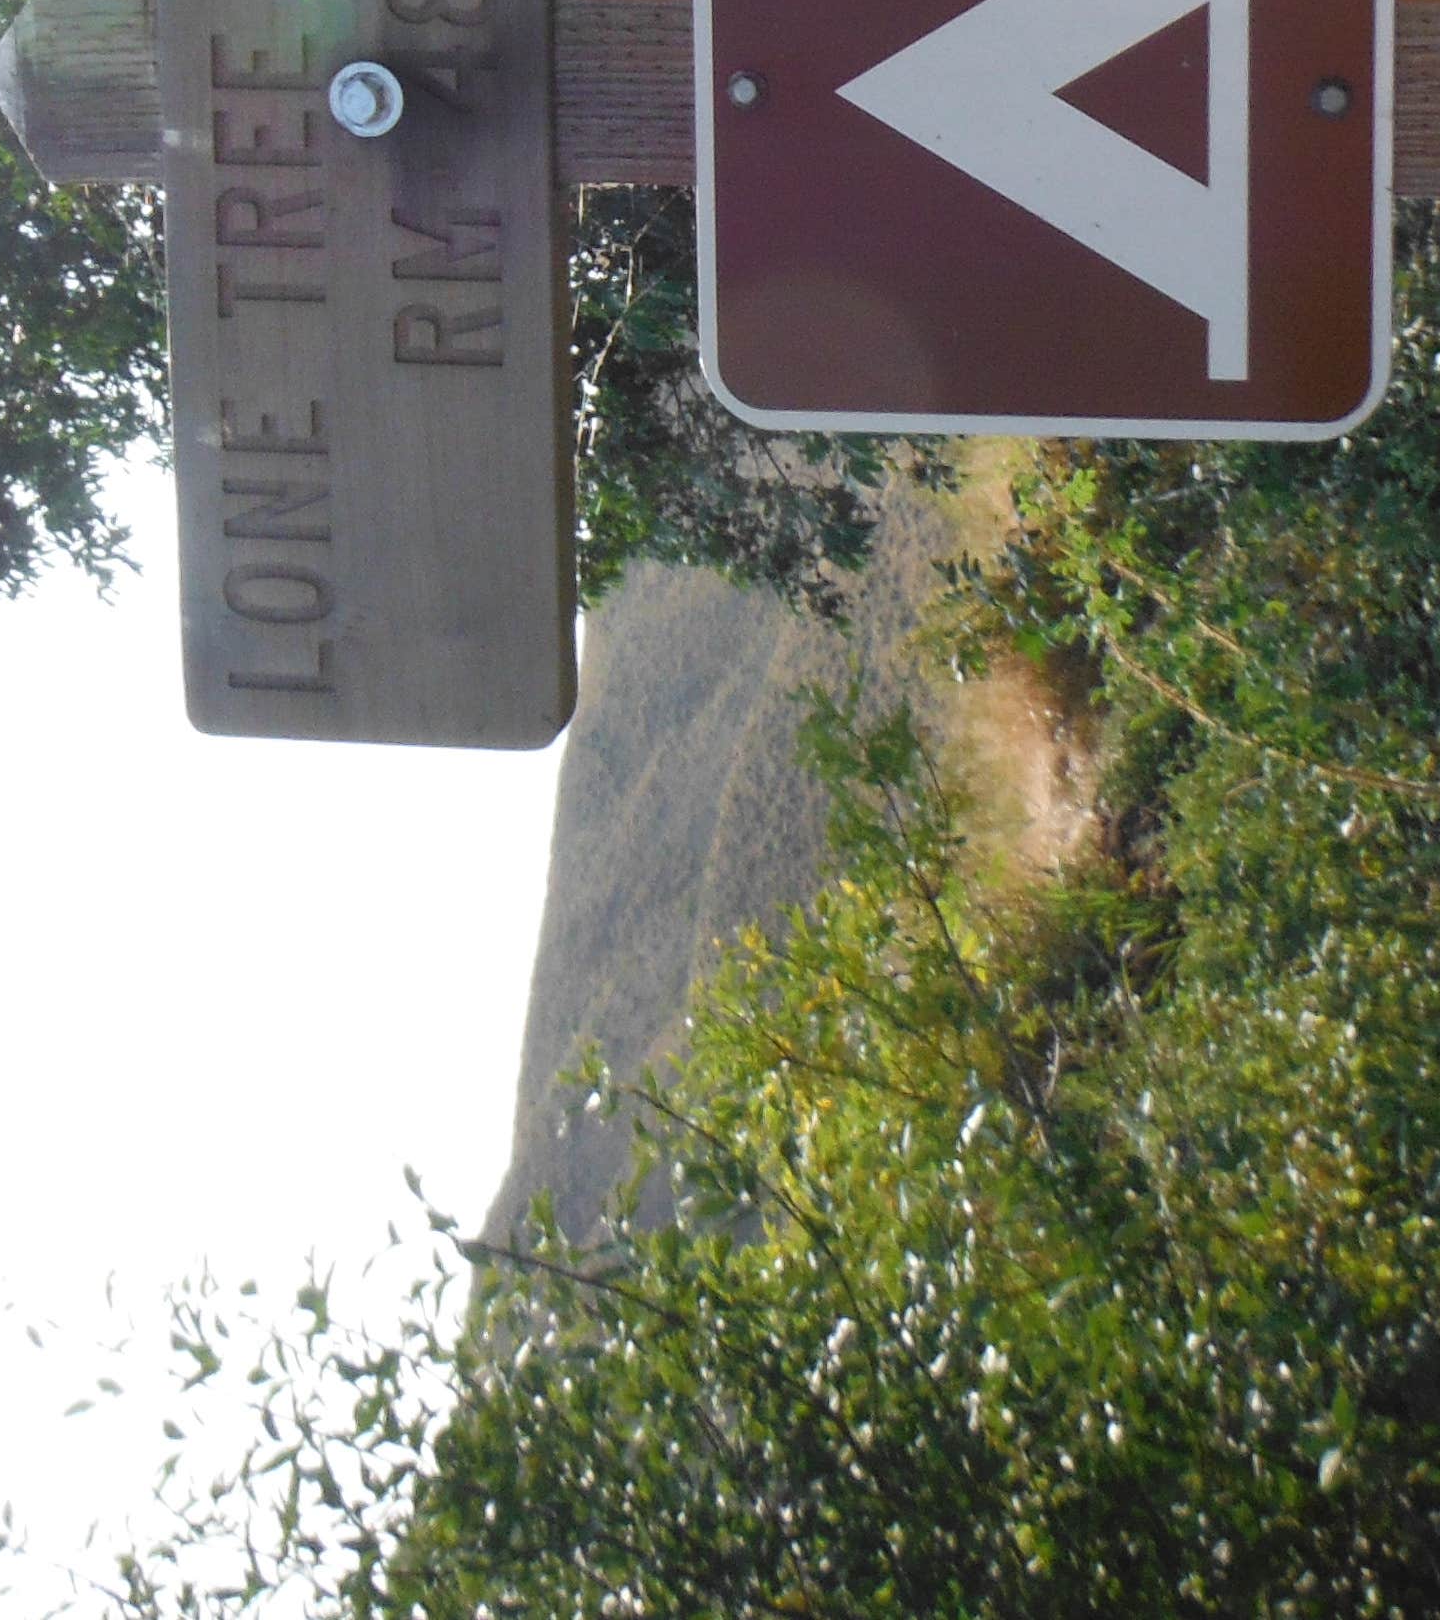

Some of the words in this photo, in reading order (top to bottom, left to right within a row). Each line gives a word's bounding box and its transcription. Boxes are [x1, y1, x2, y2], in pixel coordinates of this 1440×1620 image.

[211, 34, 326, 318] TREE
[390, 205, 505, 367] RM
[217, 391, 336, 693] LONE
